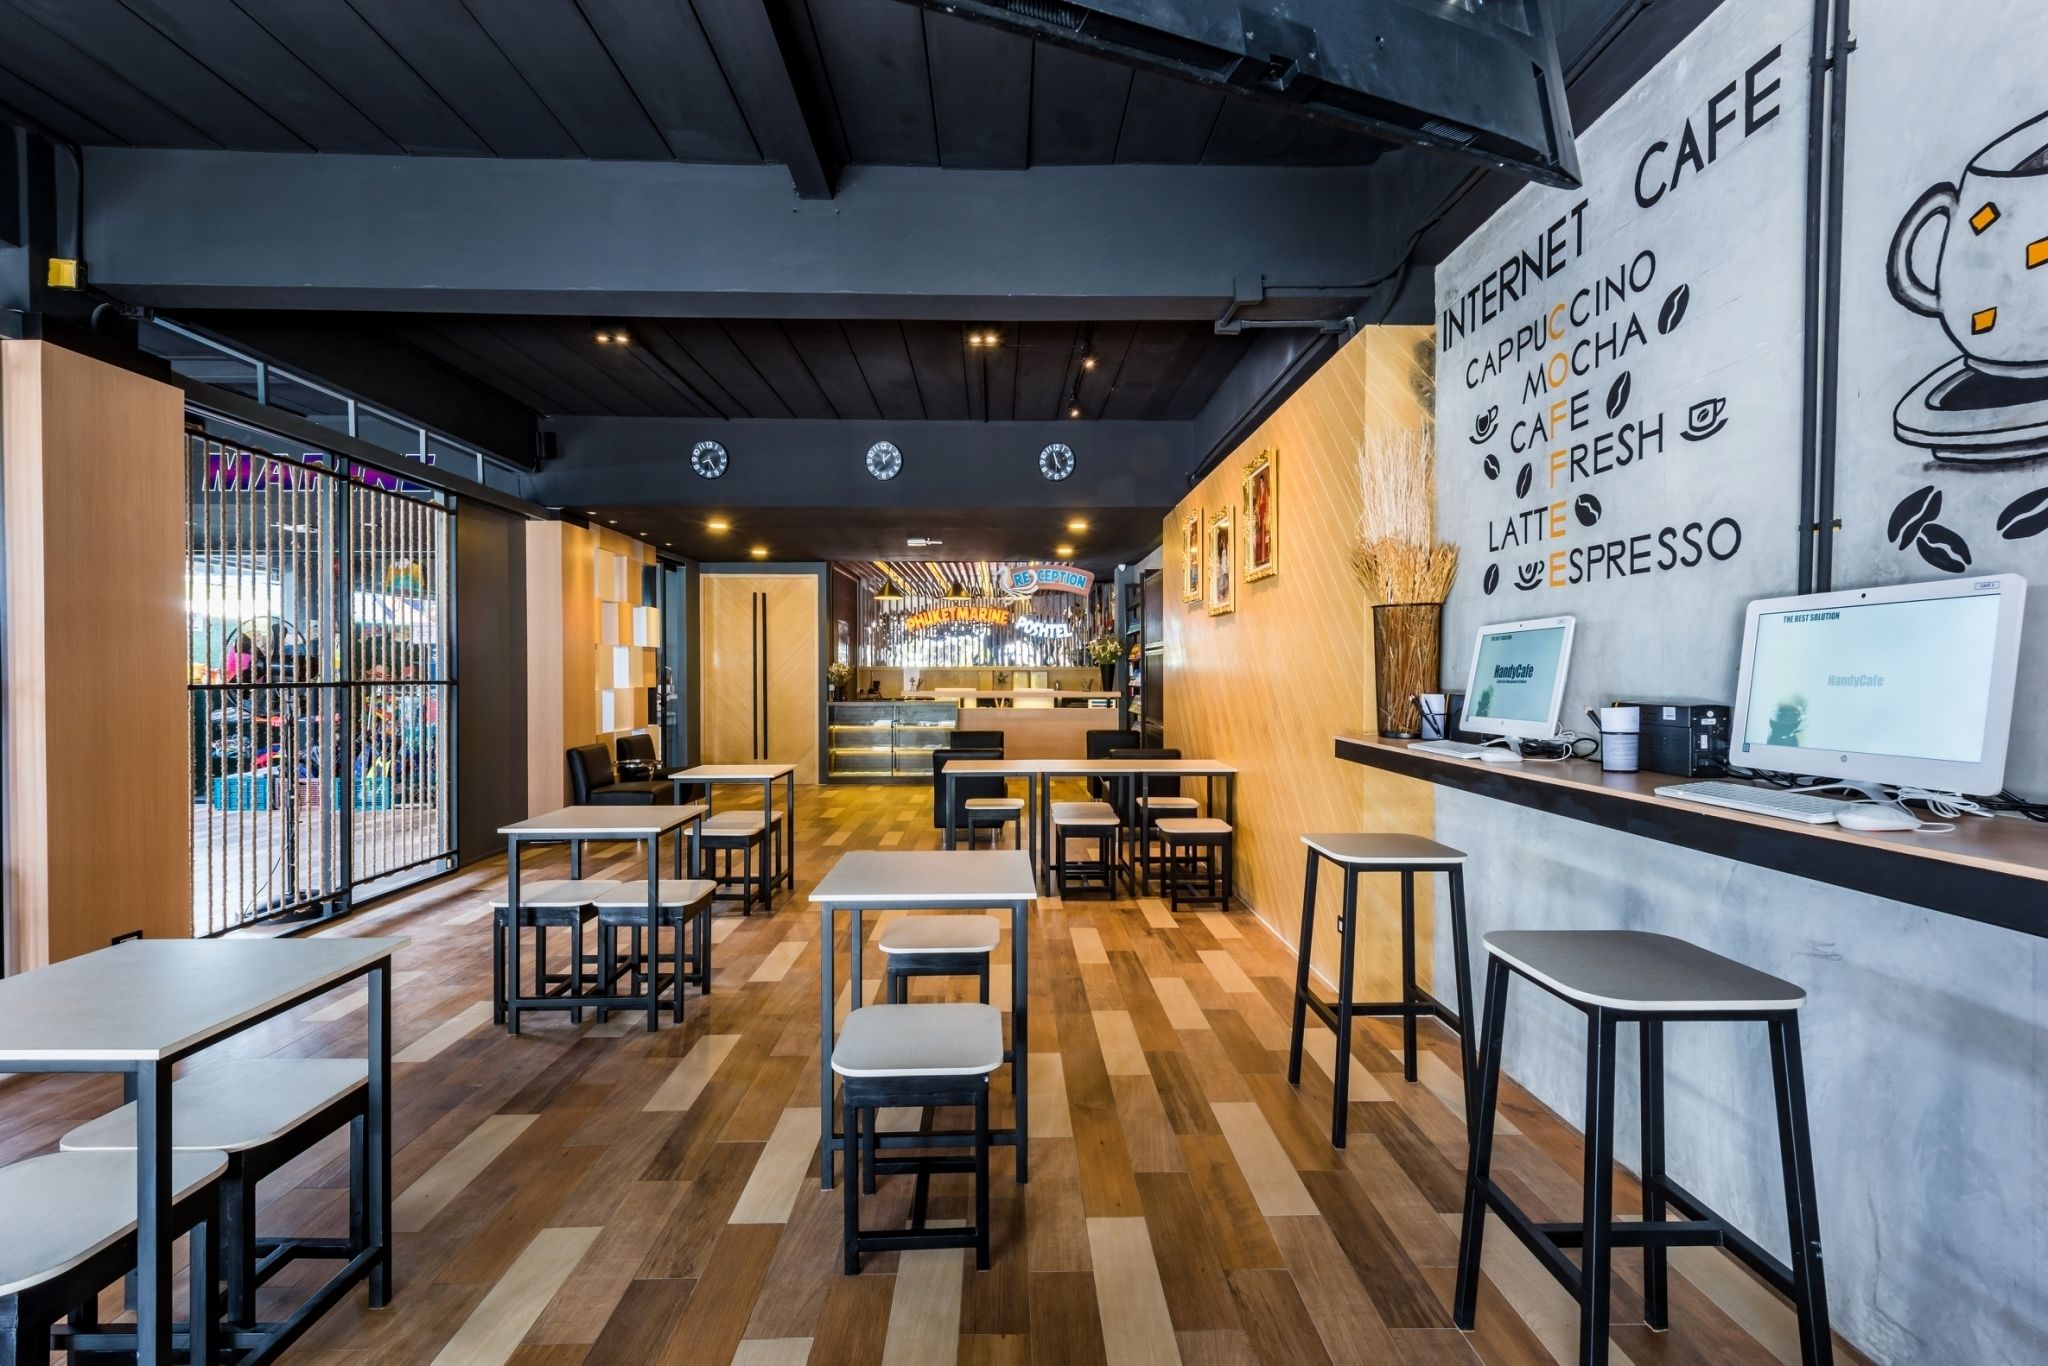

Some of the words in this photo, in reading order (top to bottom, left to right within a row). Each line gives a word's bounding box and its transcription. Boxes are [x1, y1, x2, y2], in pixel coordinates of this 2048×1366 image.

[1443, 198, 1588, 352] INTERNET
[1634, 43, 1782, 209] CAFE
[1466, 250, 1656, 389] CAPPUCCINO
[1523, 312, 1648, 404] MOCHA
[1510, 389, 1589, 454] CAFE
[1550, 412, 1663, 488] FRESH
[1489, 501, 1567, 552] LATTE
[1549, 517, 1742, 587] ESPRESSO
[1016, 616, 1072, 638] POSHTEL
[1783, 615, 1793, 623] THE
[1794, 614, 1809, 622] BEST
[1810, 612, 1840, 622] SOLUTION
[1494, 663, 1534, 679] HandyCafe
[1828, 674, 1884, 688] HandyCafe
